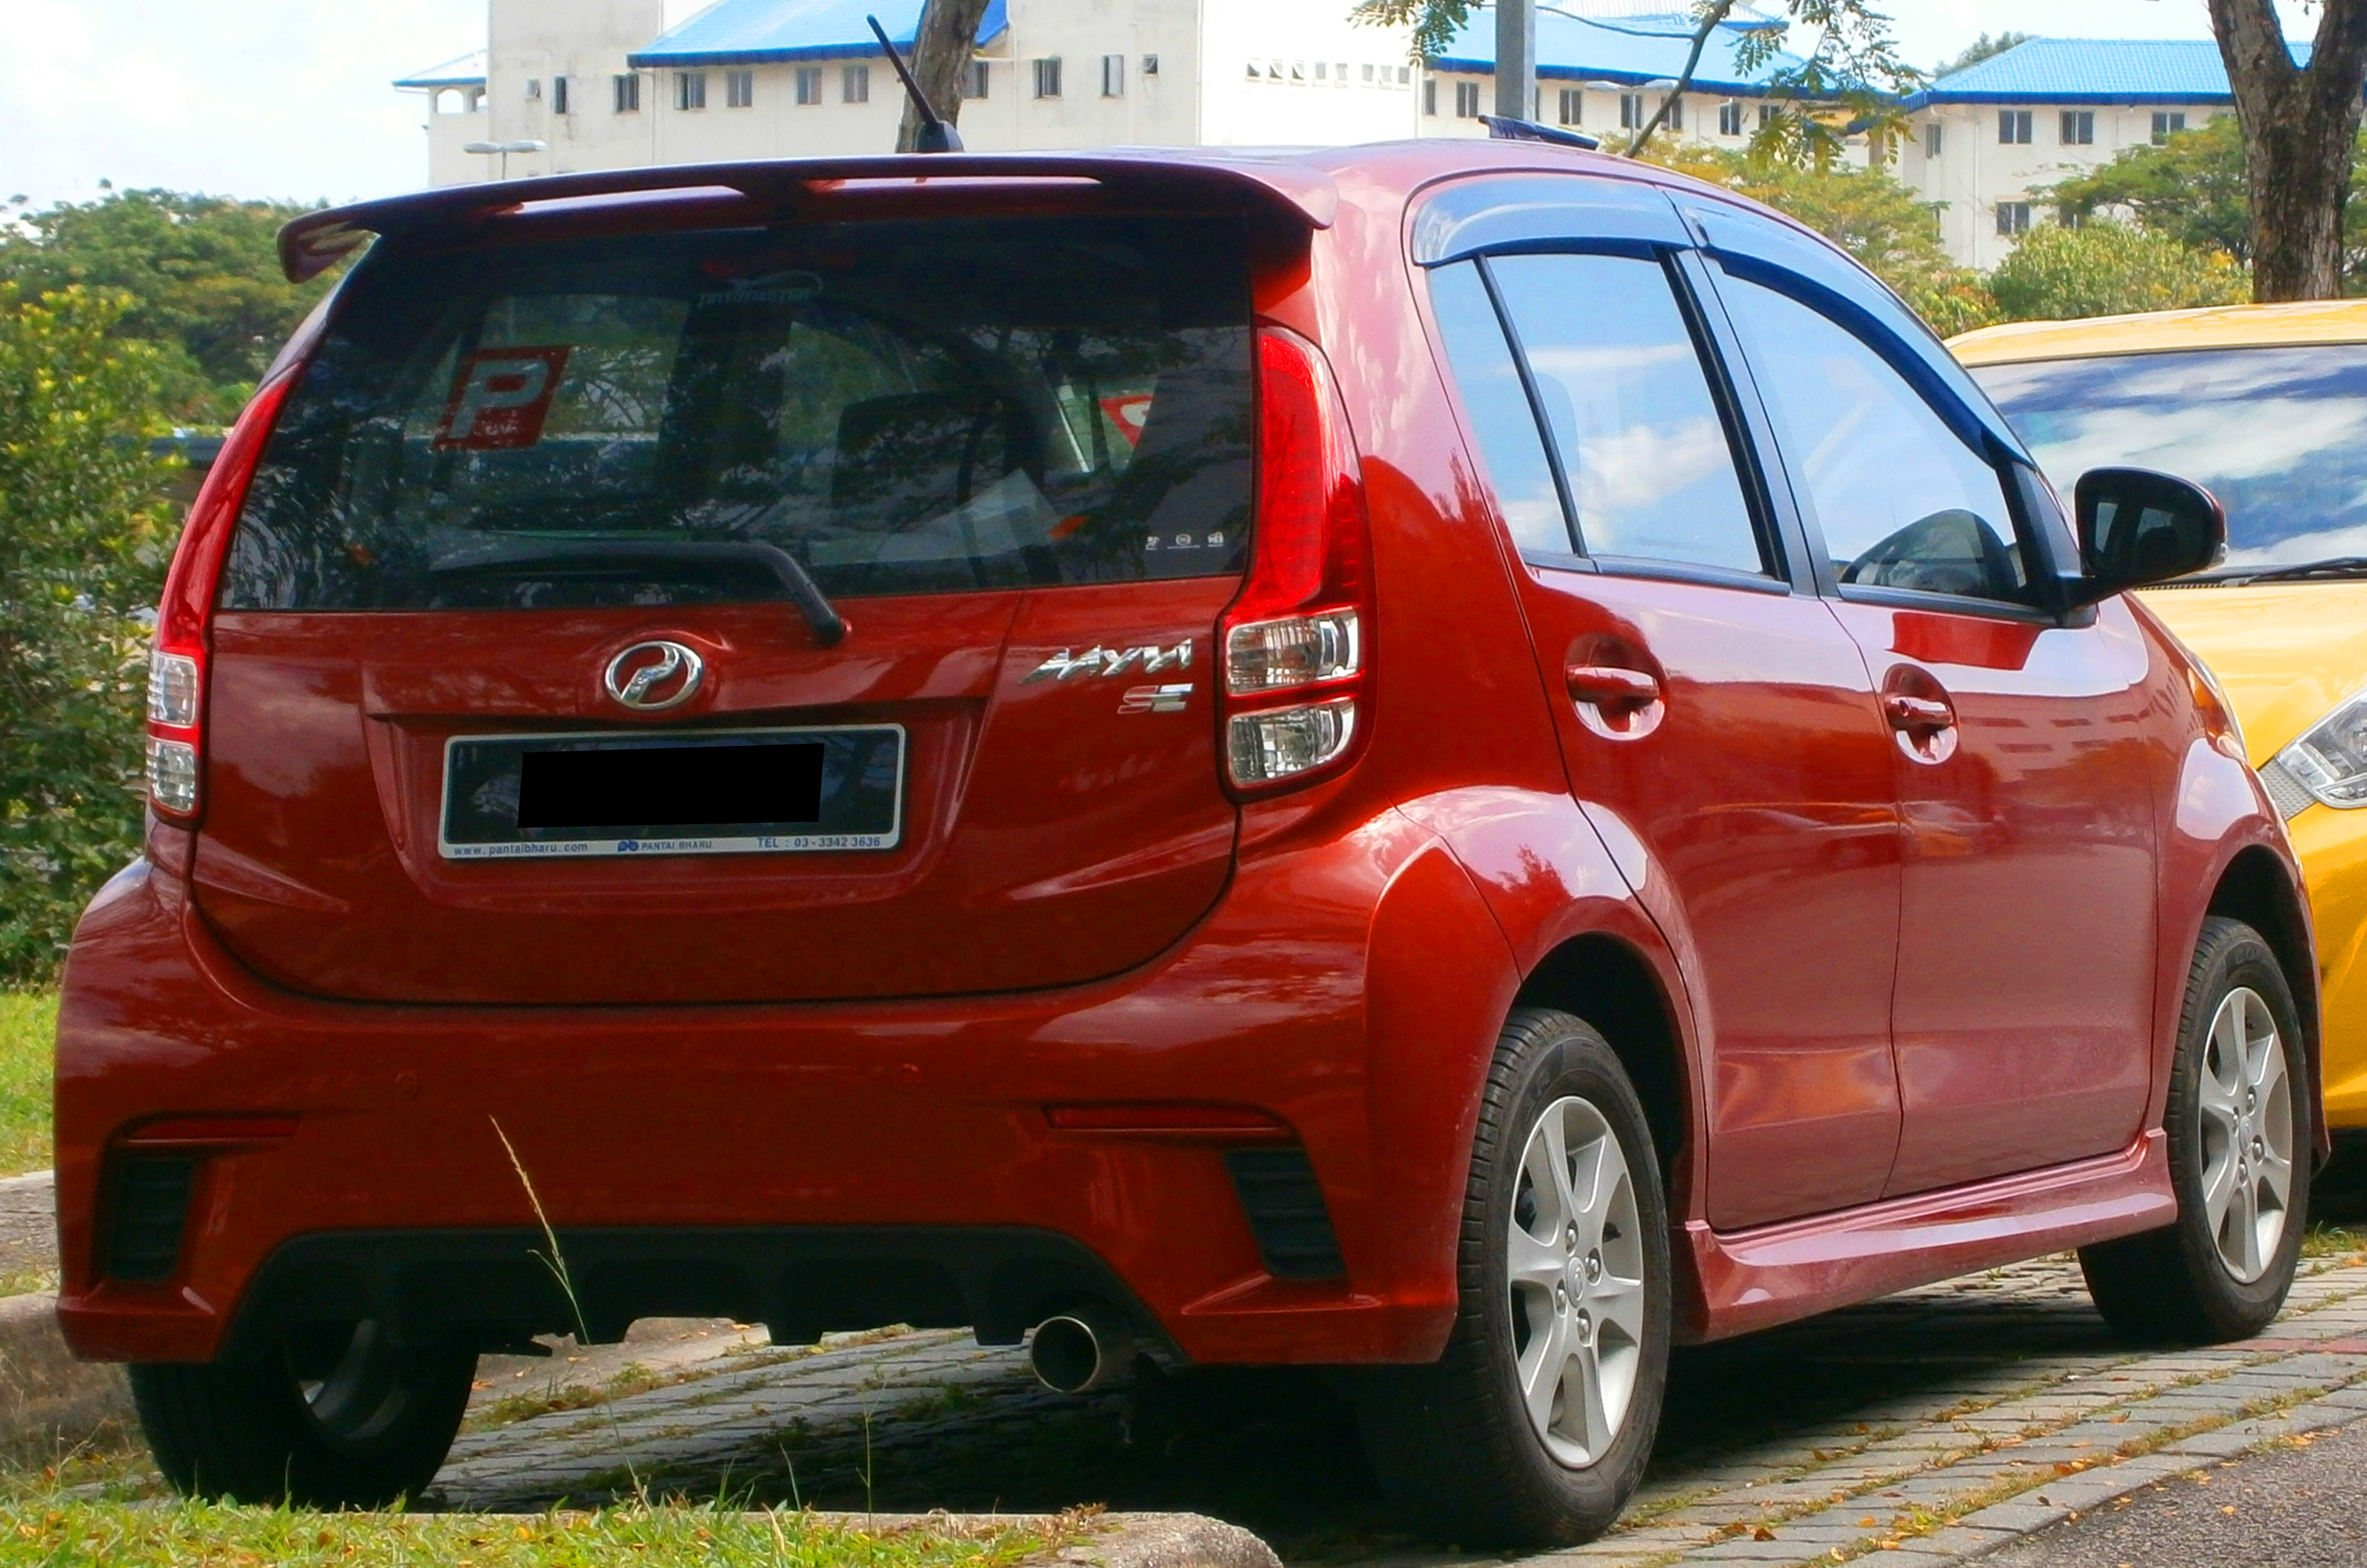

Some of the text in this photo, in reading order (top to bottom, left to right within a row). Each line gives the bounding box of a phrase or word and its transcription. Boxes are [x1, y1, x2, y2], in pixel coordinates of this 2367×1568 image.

[450, 358, 549, 438] P
[641, 841, 675, 850] PANTAI
[756, 837, 779, 848] TEL
[851, 835, 881, 847] 3636
